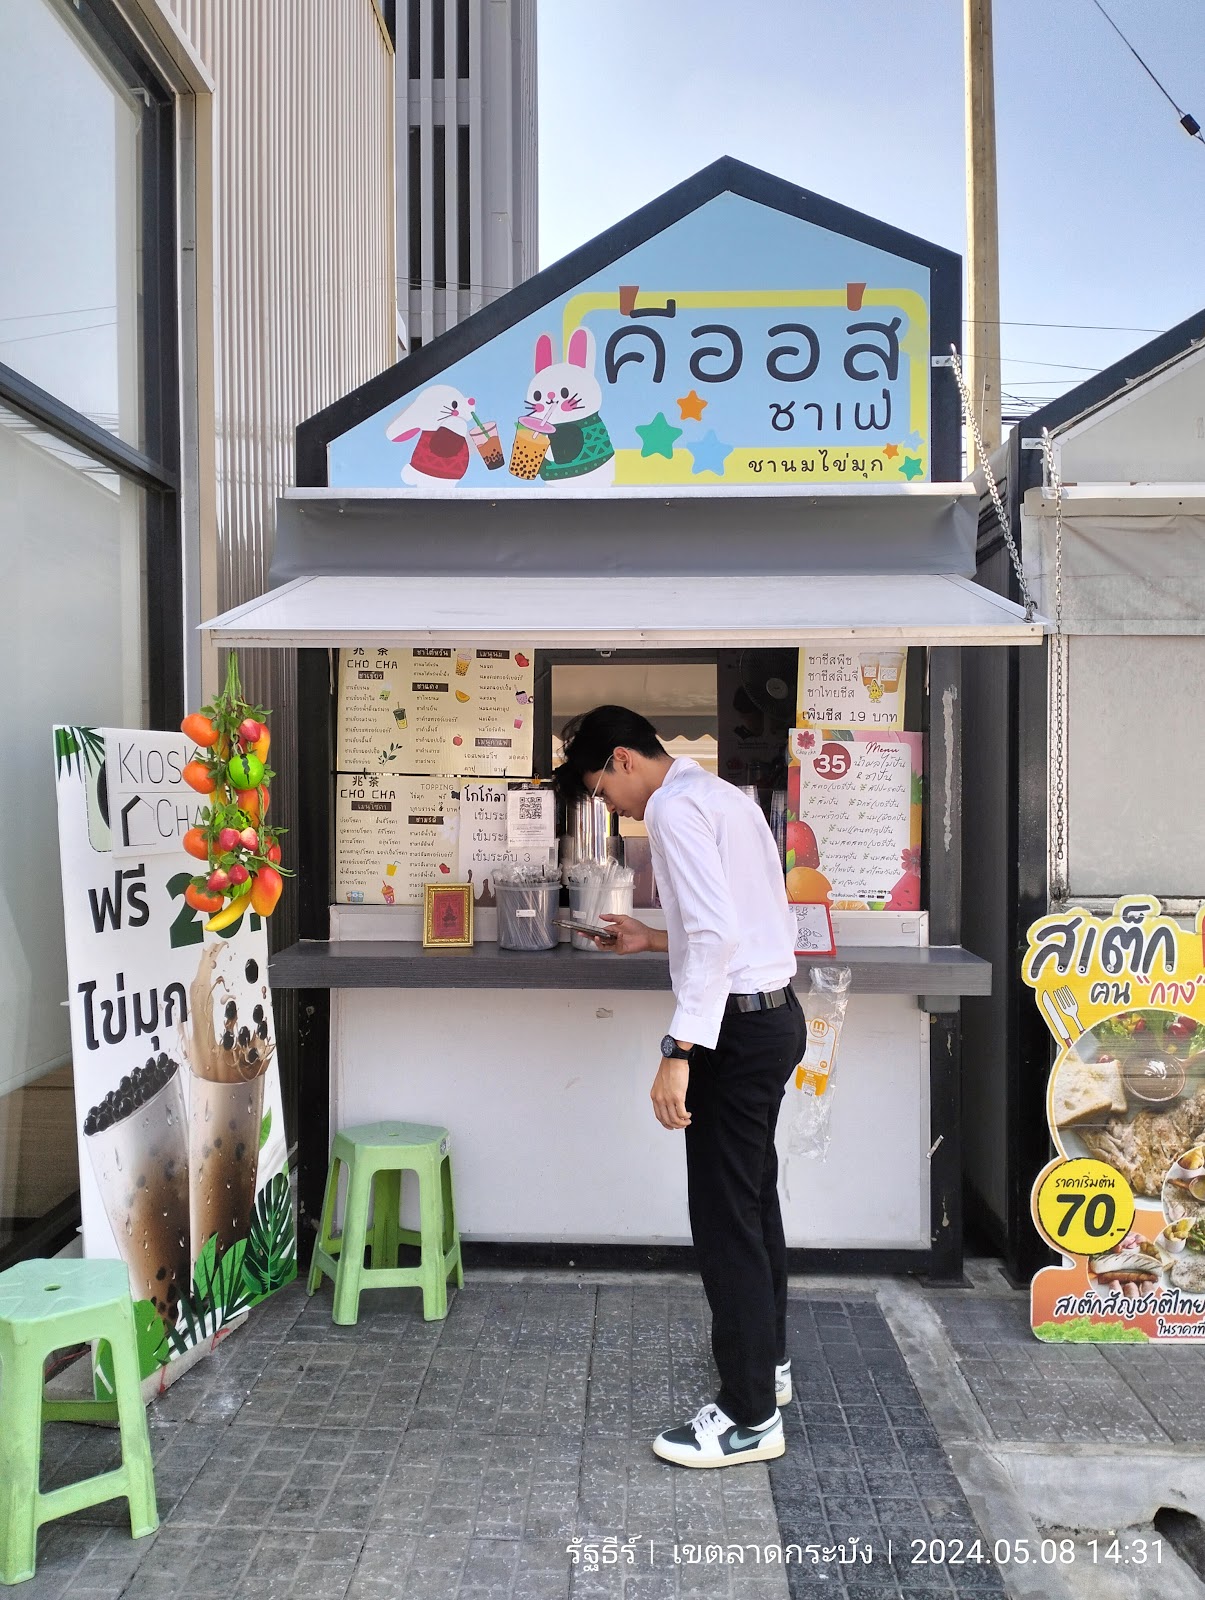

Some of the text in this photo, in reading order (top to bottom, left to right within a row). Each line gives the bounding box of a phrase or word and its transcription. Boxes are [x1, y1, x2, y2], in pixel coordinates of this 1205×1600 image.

[748, 449, 884, 478] ชานมไข่มุก
[347, 659, 398, 669] CHO CHA
[808, 652, 853, 666] ชาชีสพีช
[807, 685, 856, 699] ชาไทยชีส
[802, 703, 898, 723] เพิ่มชีส 19 บาท
[865, 741, 900, 754] Menu
[816, 754, 847, 774] 35
[340, 789, 396, 800] CHO CHA
[420, 783, 454, 791] TOPPING
[464, 784, 507, 803] โกโก้ลา
[472, 849, 532, 863] เข้มระดับ 3
[88, 863, 151, 934] ฟรี
[1031, 904, 1176, 977] สเต็ก
[78, 972, 188, 1051] ไข่มุก
[1055, 1172, 1116, 1189] ราคาเริ่มต้น
[1054, 1288, 1205, 1319] สเต็กสัญชาติไทย
